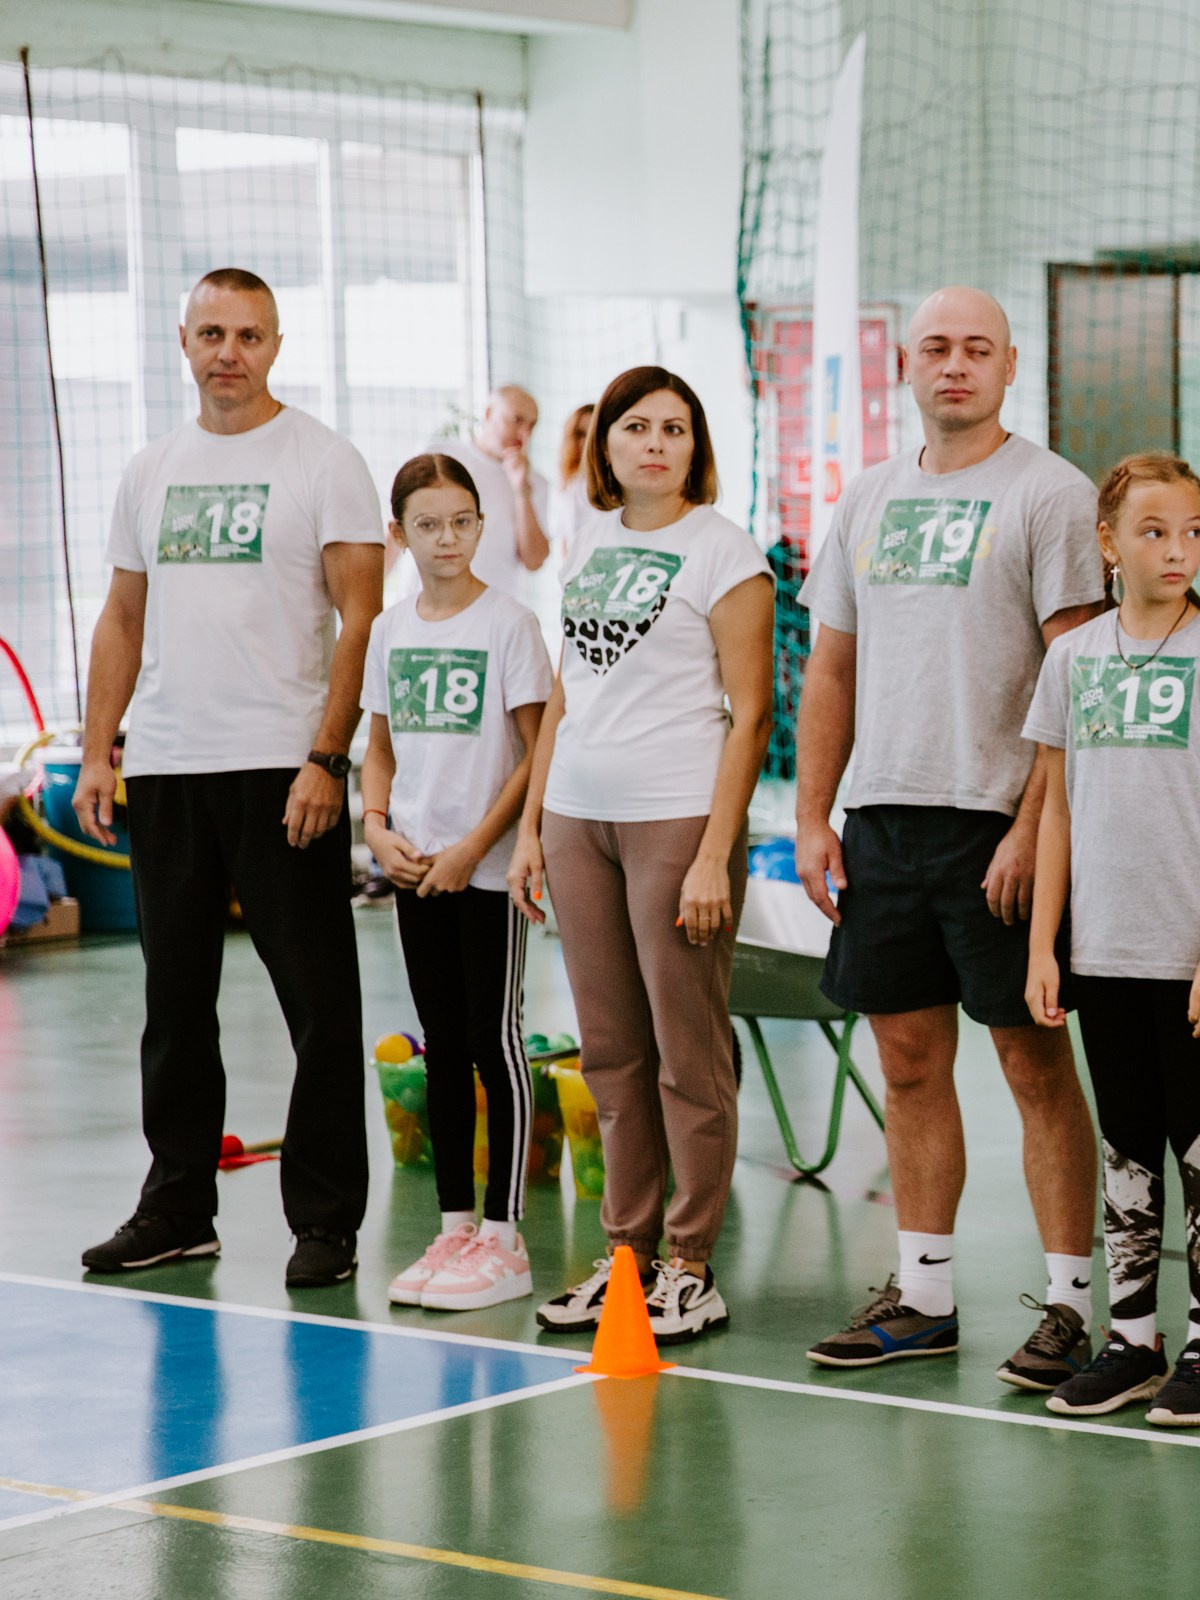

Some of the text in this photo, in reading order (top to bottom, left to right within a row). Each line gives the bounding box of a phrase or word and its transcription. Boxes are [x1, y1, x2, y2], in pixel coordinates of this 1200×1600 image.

[205, 502, 260, 545] 18
[918, 518, 975, 563] 19
[607, 563, 669, 604] 18
[419, 667, 479, 714] 18
[1117, 675, 1185, 724] 19
